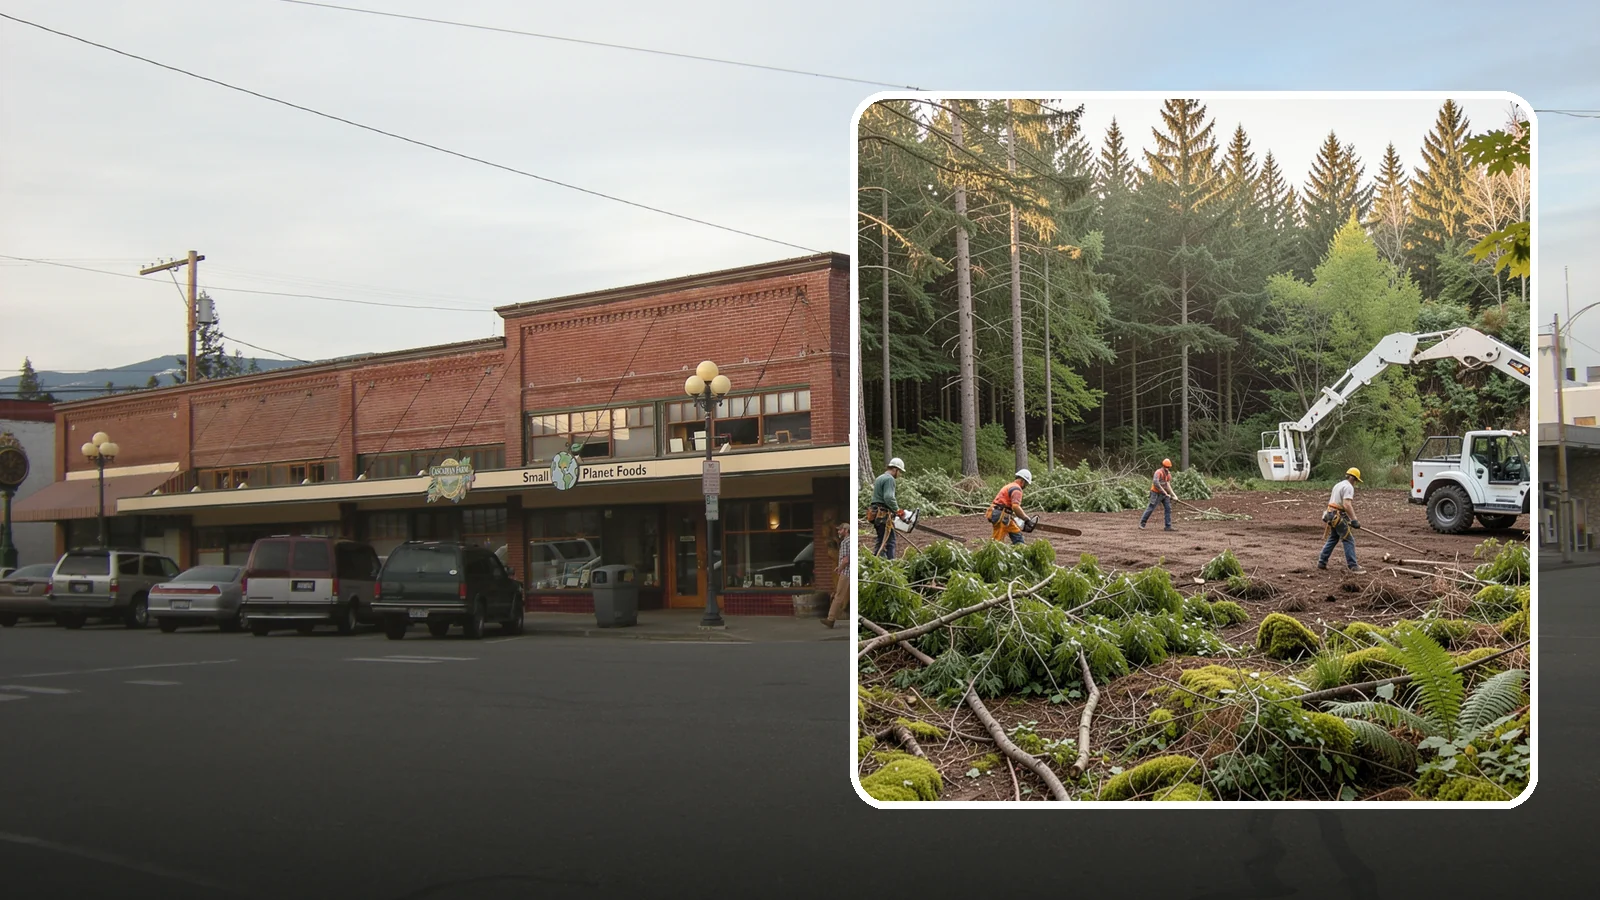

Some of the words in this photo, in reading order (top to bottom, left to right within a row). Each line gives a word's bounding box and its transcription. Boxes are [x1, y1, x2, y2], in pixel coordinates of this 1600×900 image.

[523, 471, 549, 483] Small
[583, 468, 614, 479] Planet
[616, 464, 647, 477] Foods
